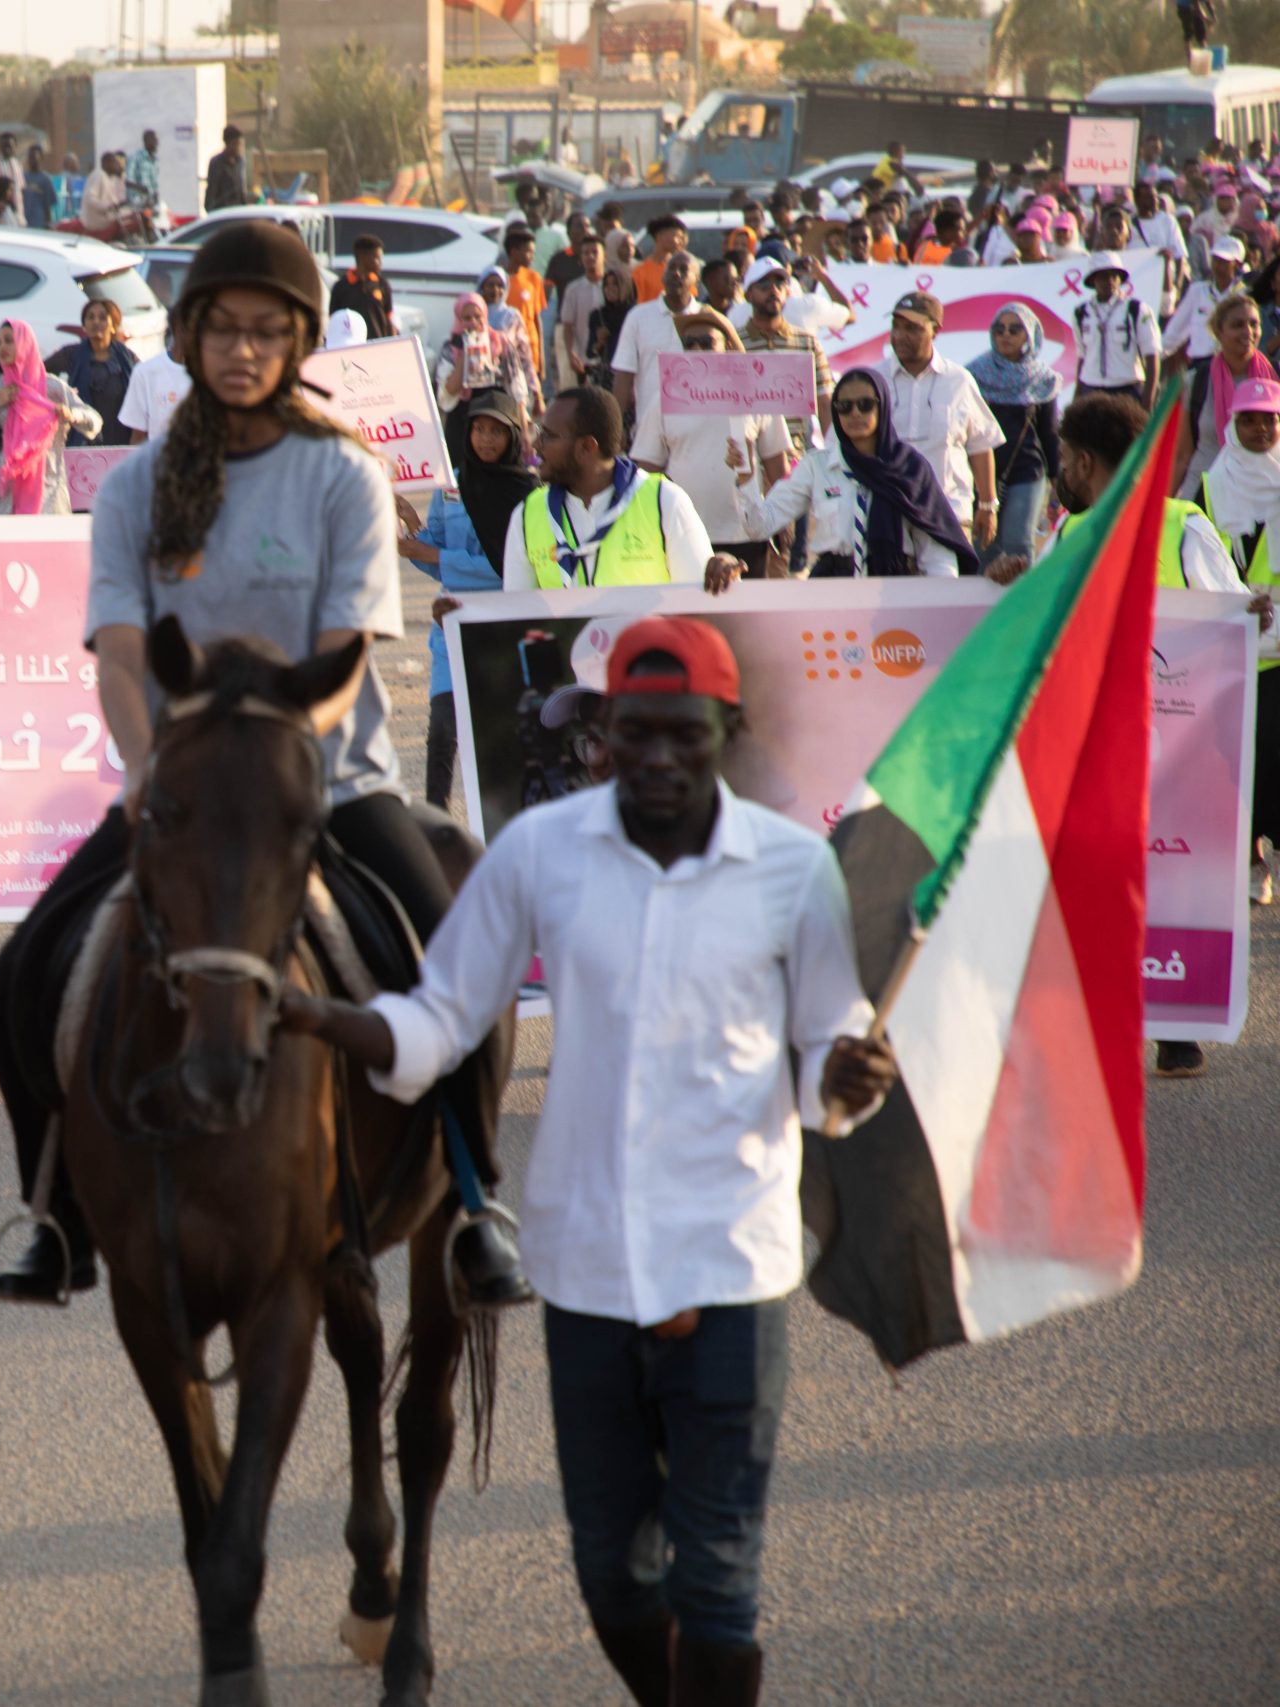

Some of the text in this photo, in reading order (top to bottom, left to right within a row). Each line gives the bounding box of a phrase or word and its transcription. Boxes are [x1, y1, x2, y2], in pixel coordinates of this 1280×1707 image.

[356, 416, 415, 443] حنمش
[870, 644, 927, 663] UNFPA
[15, 653, 70, 683] كلنا
